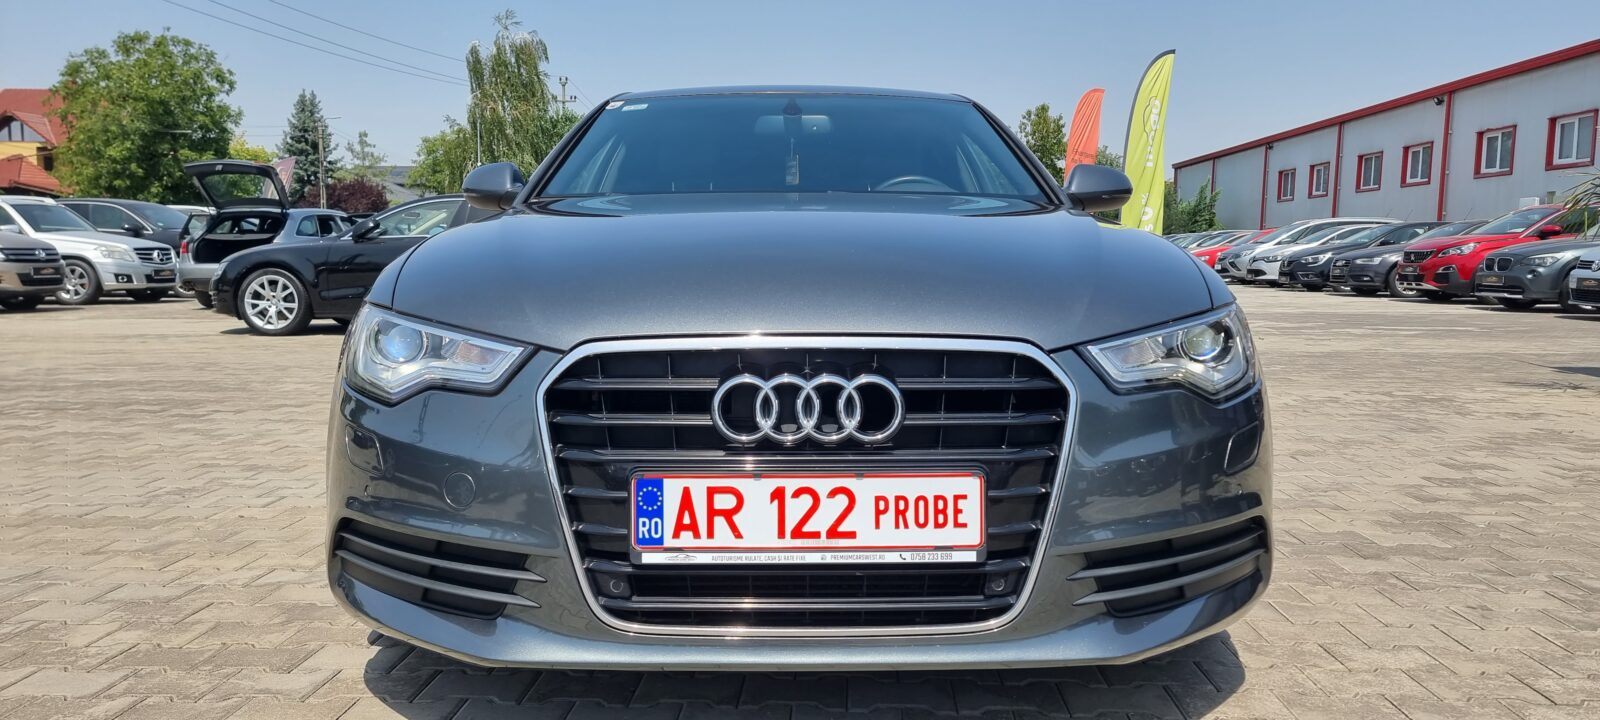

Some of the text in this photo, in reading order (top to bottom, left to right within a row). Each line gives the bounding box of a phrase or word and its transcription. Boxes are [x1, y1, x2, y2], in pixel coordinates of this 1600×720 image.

[671, 485, 968, 540] AR 122 PROBE
[638, 517, 662, 539] RO
[910, 552, 953, 561] 0758 233 699
